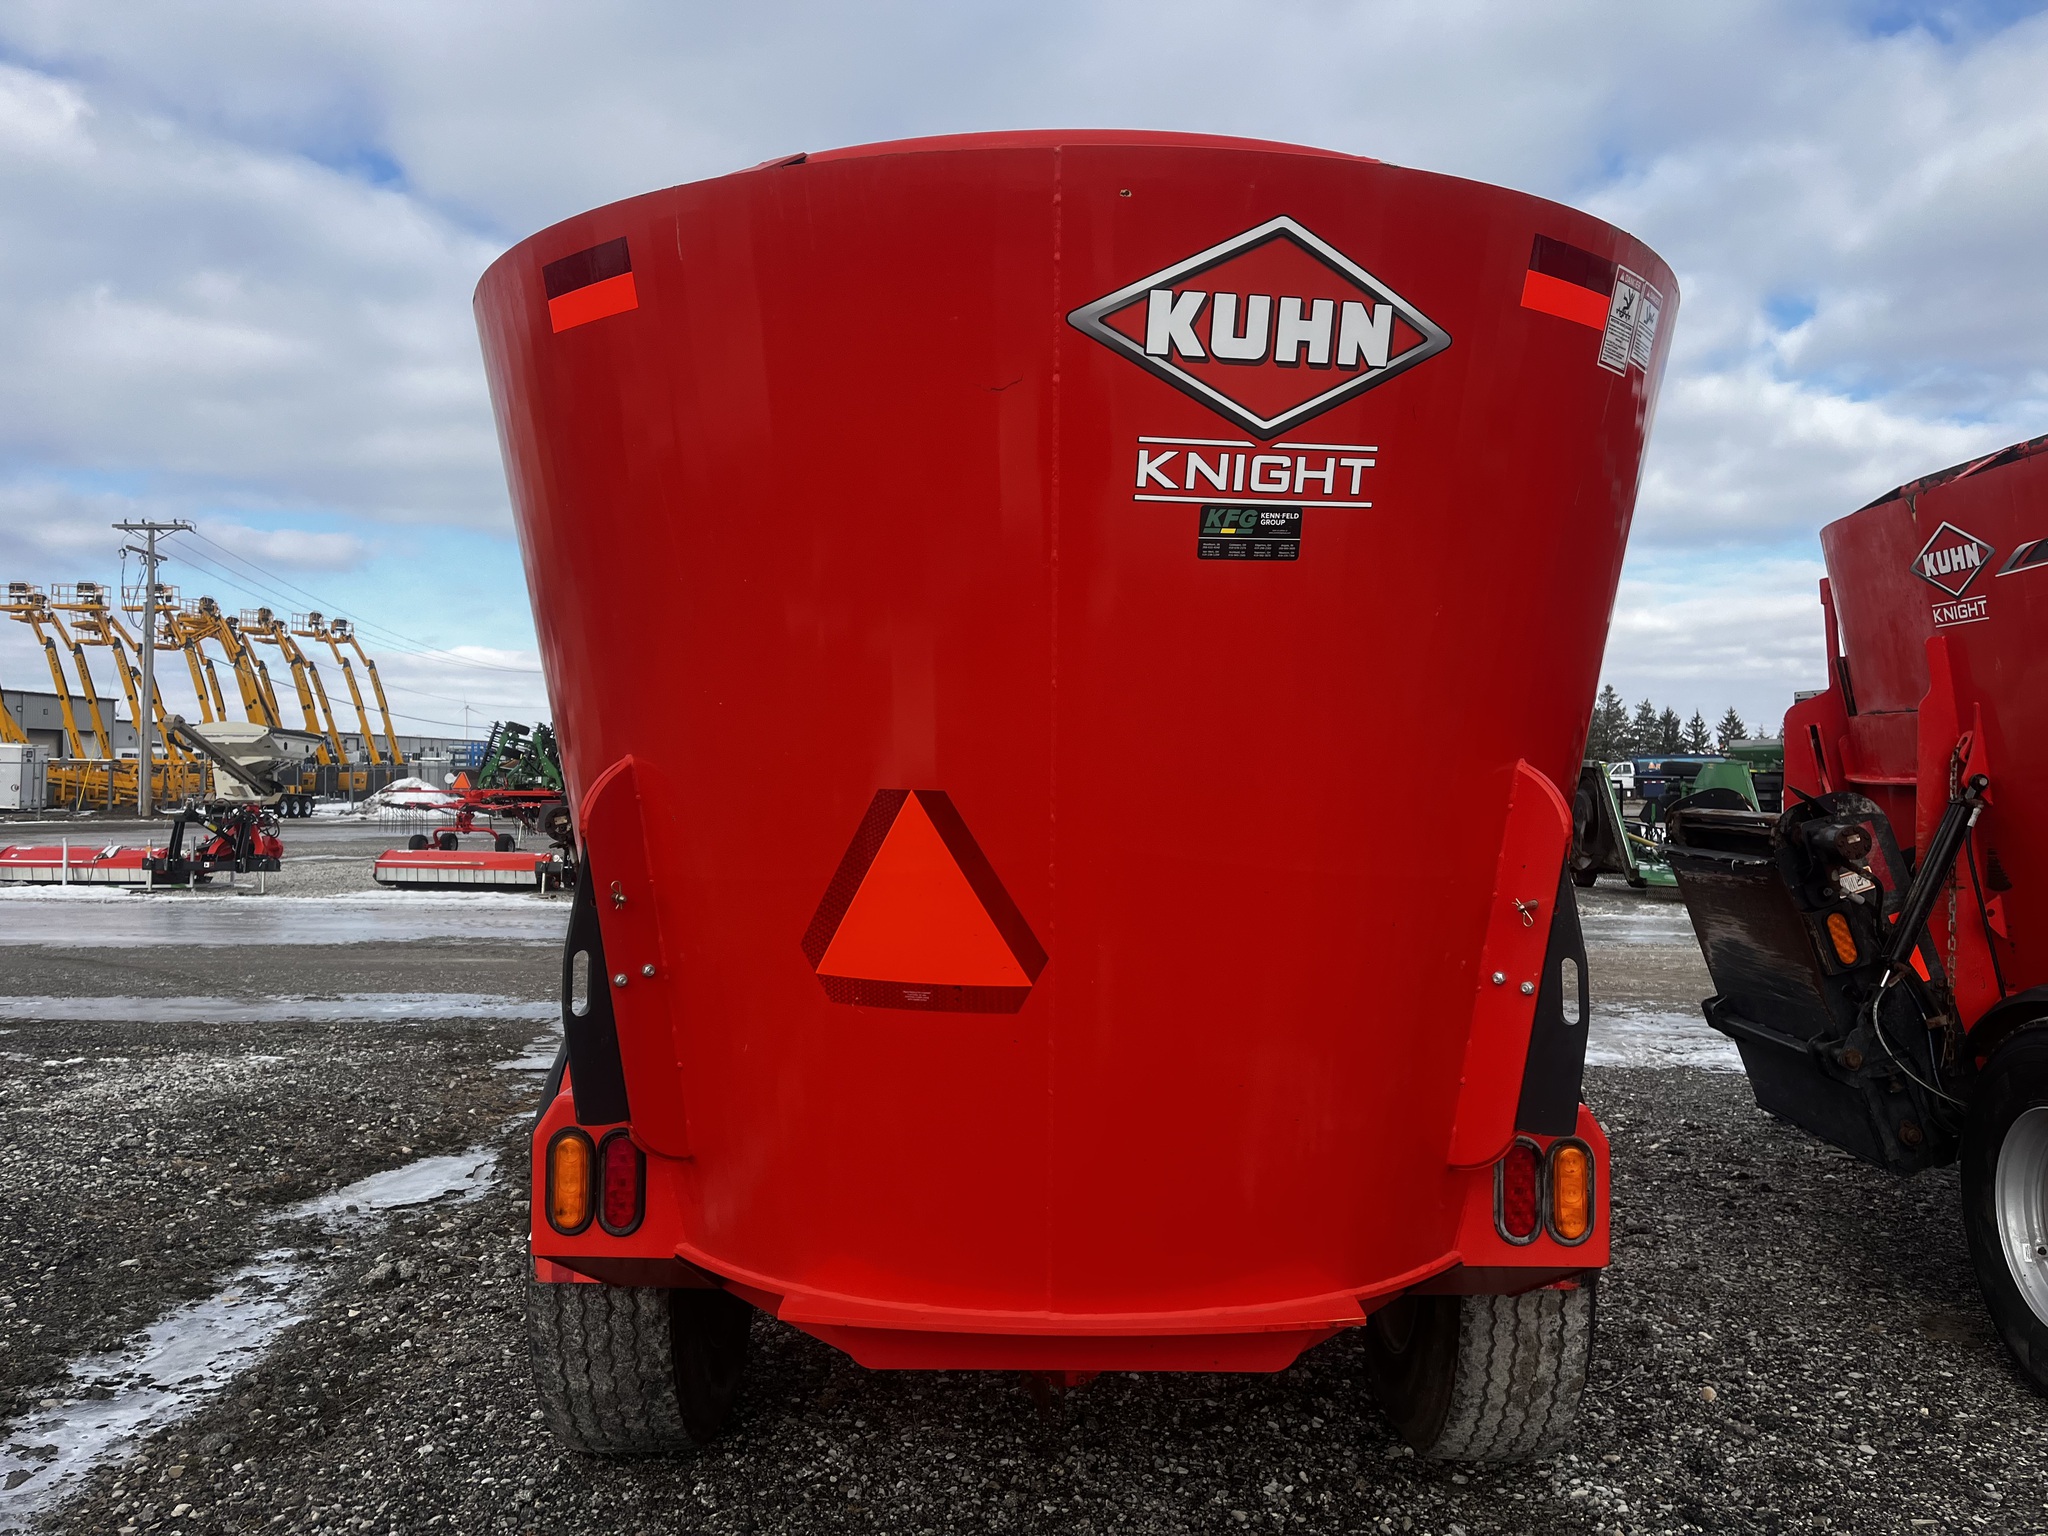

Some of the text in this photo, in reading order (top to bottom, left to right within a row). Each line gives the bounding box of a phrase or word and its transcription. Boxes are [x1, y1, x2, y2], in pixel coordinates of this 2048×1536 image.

[1145, 289, 1394, 368] KUHN
[1136, 449, 1377, 496] KNIGHT
[1205, 508, 1258, 528] KFG
[1923, 542, 1981, 577] KUHN
[1933, 600, 1987, 623] KNIGHT
